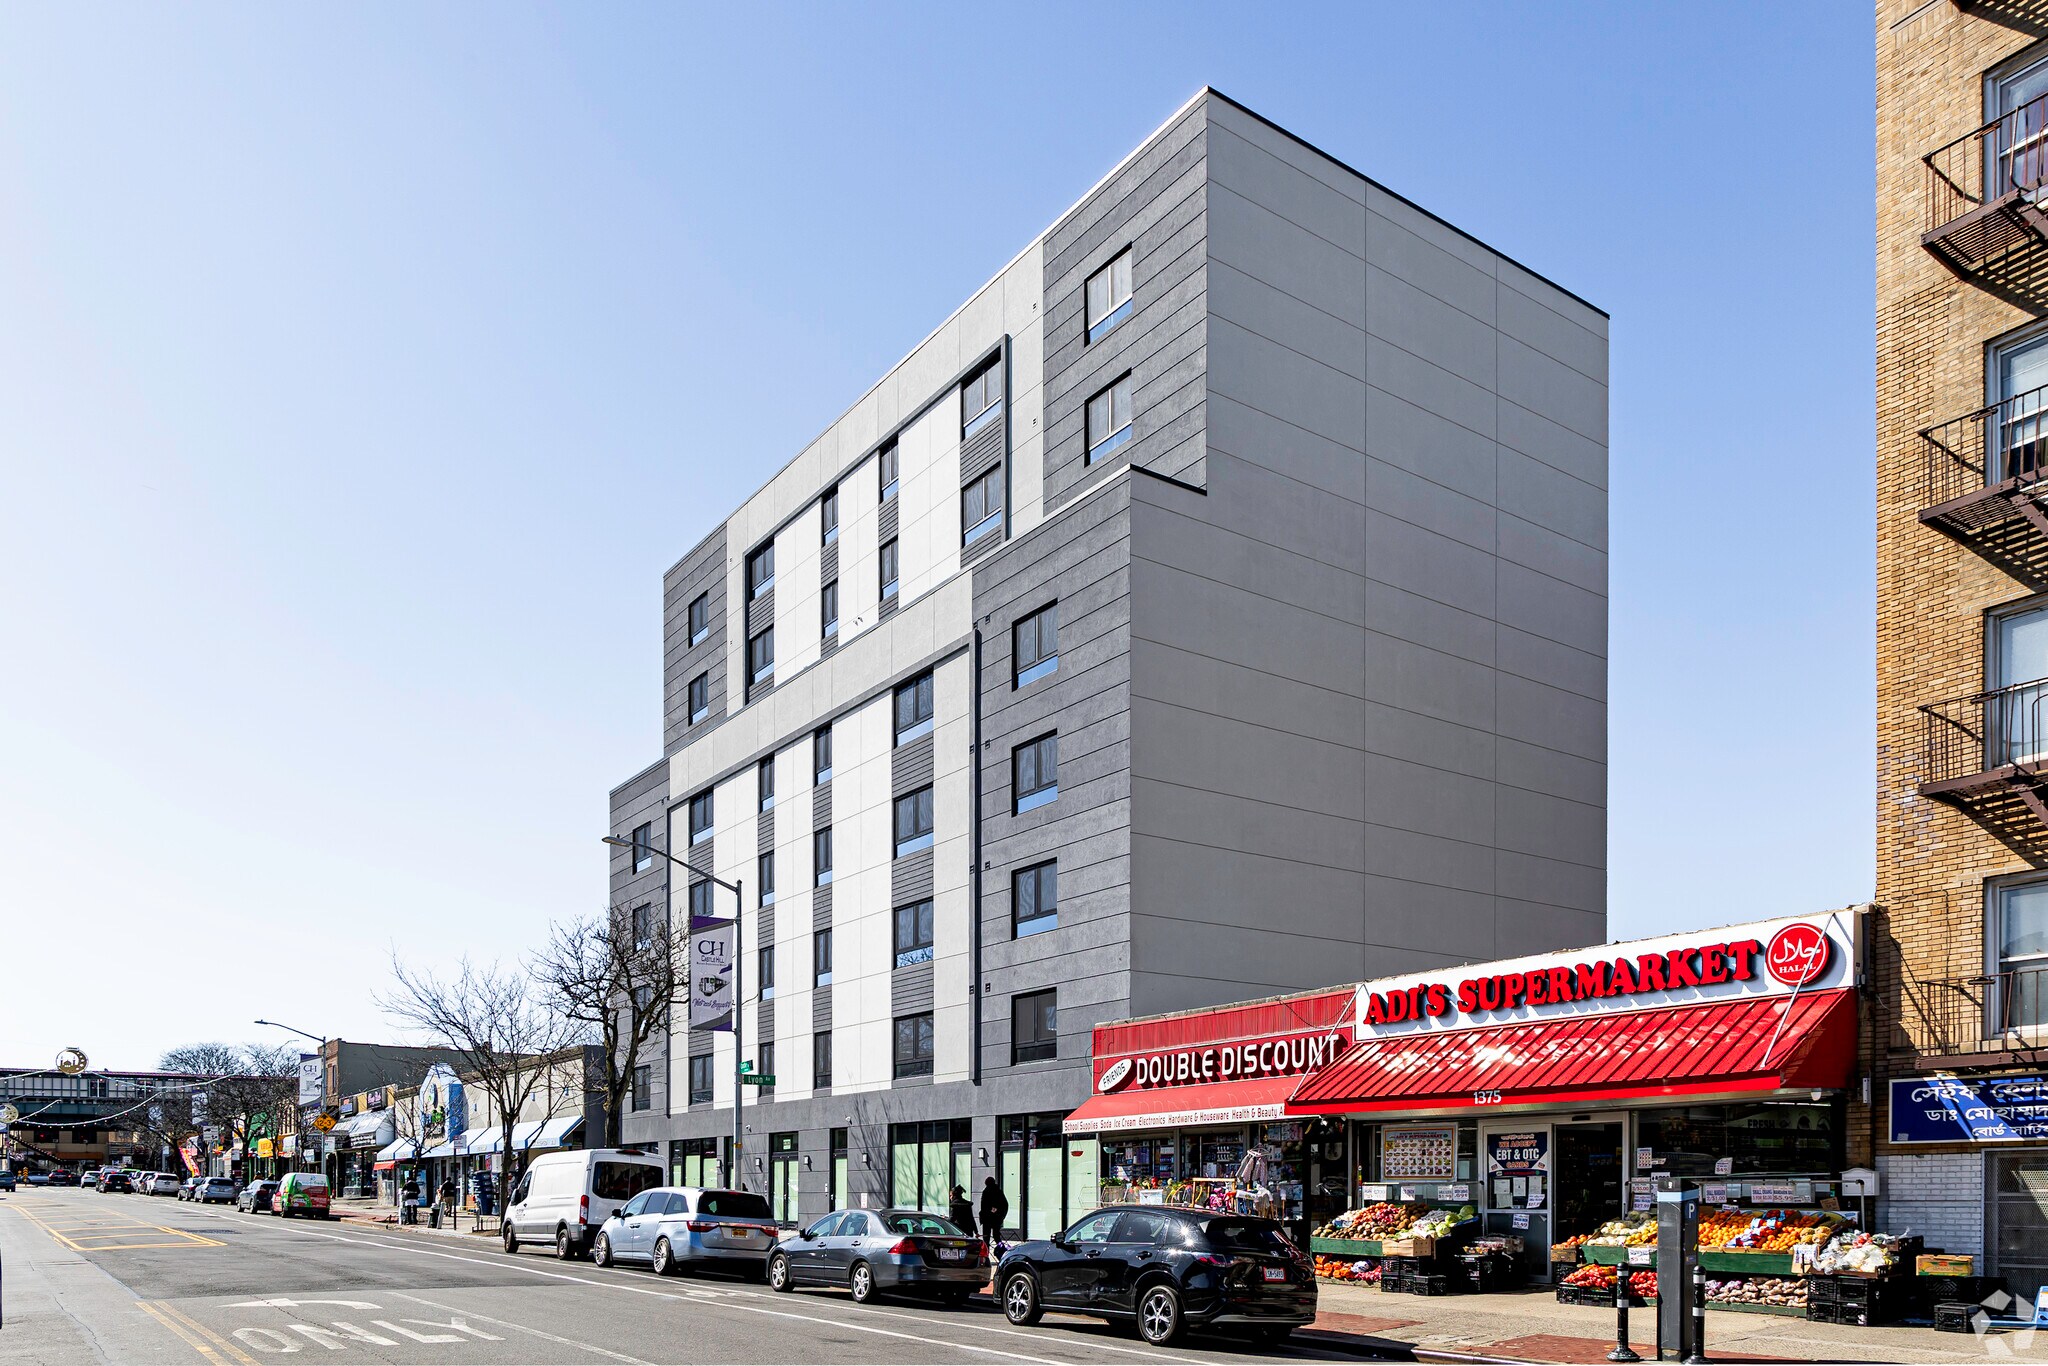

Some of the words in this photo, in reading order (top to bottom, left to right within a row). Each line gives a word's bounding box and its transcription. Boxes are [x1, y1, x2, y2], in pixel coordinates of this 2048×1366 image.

[698, 939, 725, 956] CH
[1773, 938, 1821, 963] حلال
[1779, 963, 1816, 975] HALAL
[1363, 983, 1446, 1024] ADI'S
[1457, 939, 1758, 1014] SUPERMARKET
[1136, 1048, 1214, 1085] DOUBLE
[1222, 1034, 1339, 1076] DISCOUNT
[1102, 1062, 1126, 1086] FRIENDS
[1473, 1090, 1502, 1104] 1375
[1064, 1122, 1079, 1132] School
[1080, 1120, 1099, 1132] Supplies
[1100, 1120, 1112, 1129] Soda
[1122, 1118, 1137, 1128] Cream
[1139, 1115, 1166, 1126] Electronics
[1168, 1113, 1193, 1124] Hardware
[1194, 1113, 1199, 1122] &
[1200, 1111, 1230, 1122] Houseware
[1232, 1109, 1250, 1120] Health
[1251, 1108, 1256, 1118] &
[1257, 1106, 1278, 1118] Beauty
[1510, 1140, 1537, 1148] ACCEPT
[1496, 1148, 1512, 1161] EBT
[1513, 1149, 1521, 1160] &
[1522, 1148, 1540, 1160] OTC
[1506, 1161, 1530, 1169] CARDS
[1688, 1202, 1695, 1219] P
[232, 1317, 506, 1353] ONLY
